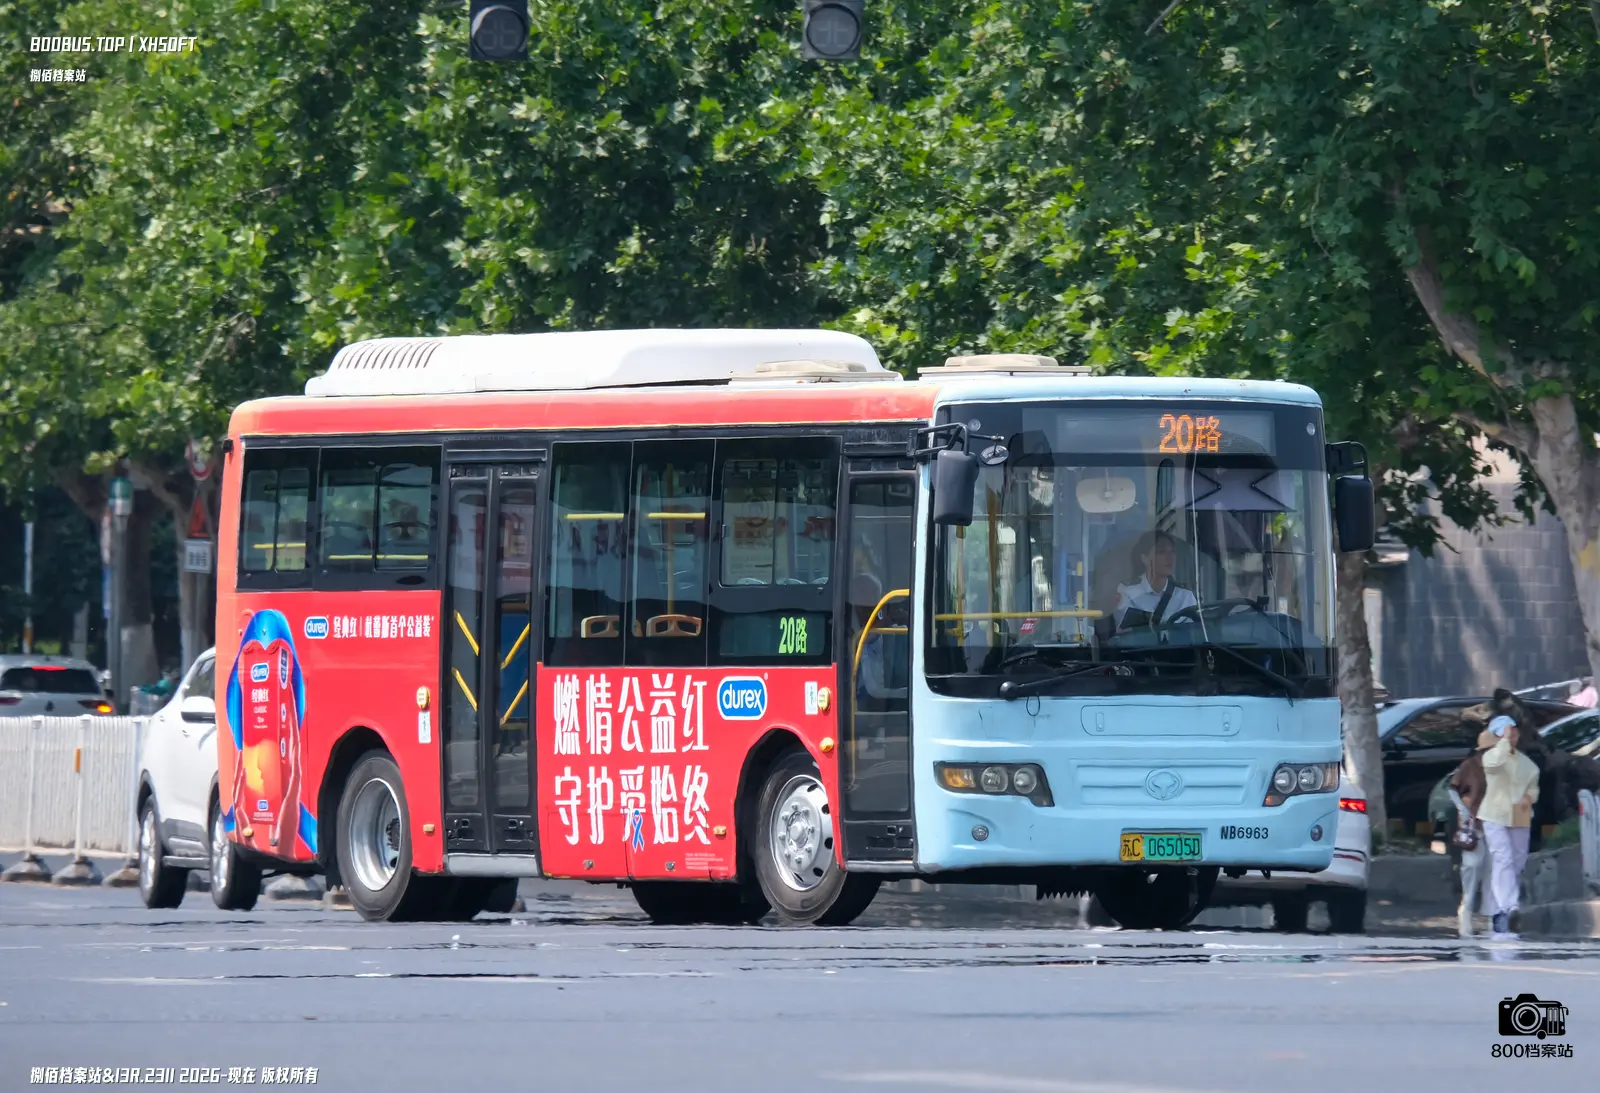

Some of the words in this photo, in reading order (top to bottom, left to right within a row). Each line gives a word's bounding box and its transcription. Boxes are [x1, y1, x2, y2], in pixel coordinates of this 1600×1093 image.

[1159, 413, 1222, 453] 20路
[333, 616, 357, 638] 经典红
[779, 616, 807, 654] 20路
[553, 673, 709, 755] 燃情公益红
[722, 685, 764, 711] durex
[554, 764, 711, 845] 守护爱始终
[1122, 837, 1141, 857] 苏C
[1220, 825, 1269, 840] NB6963
